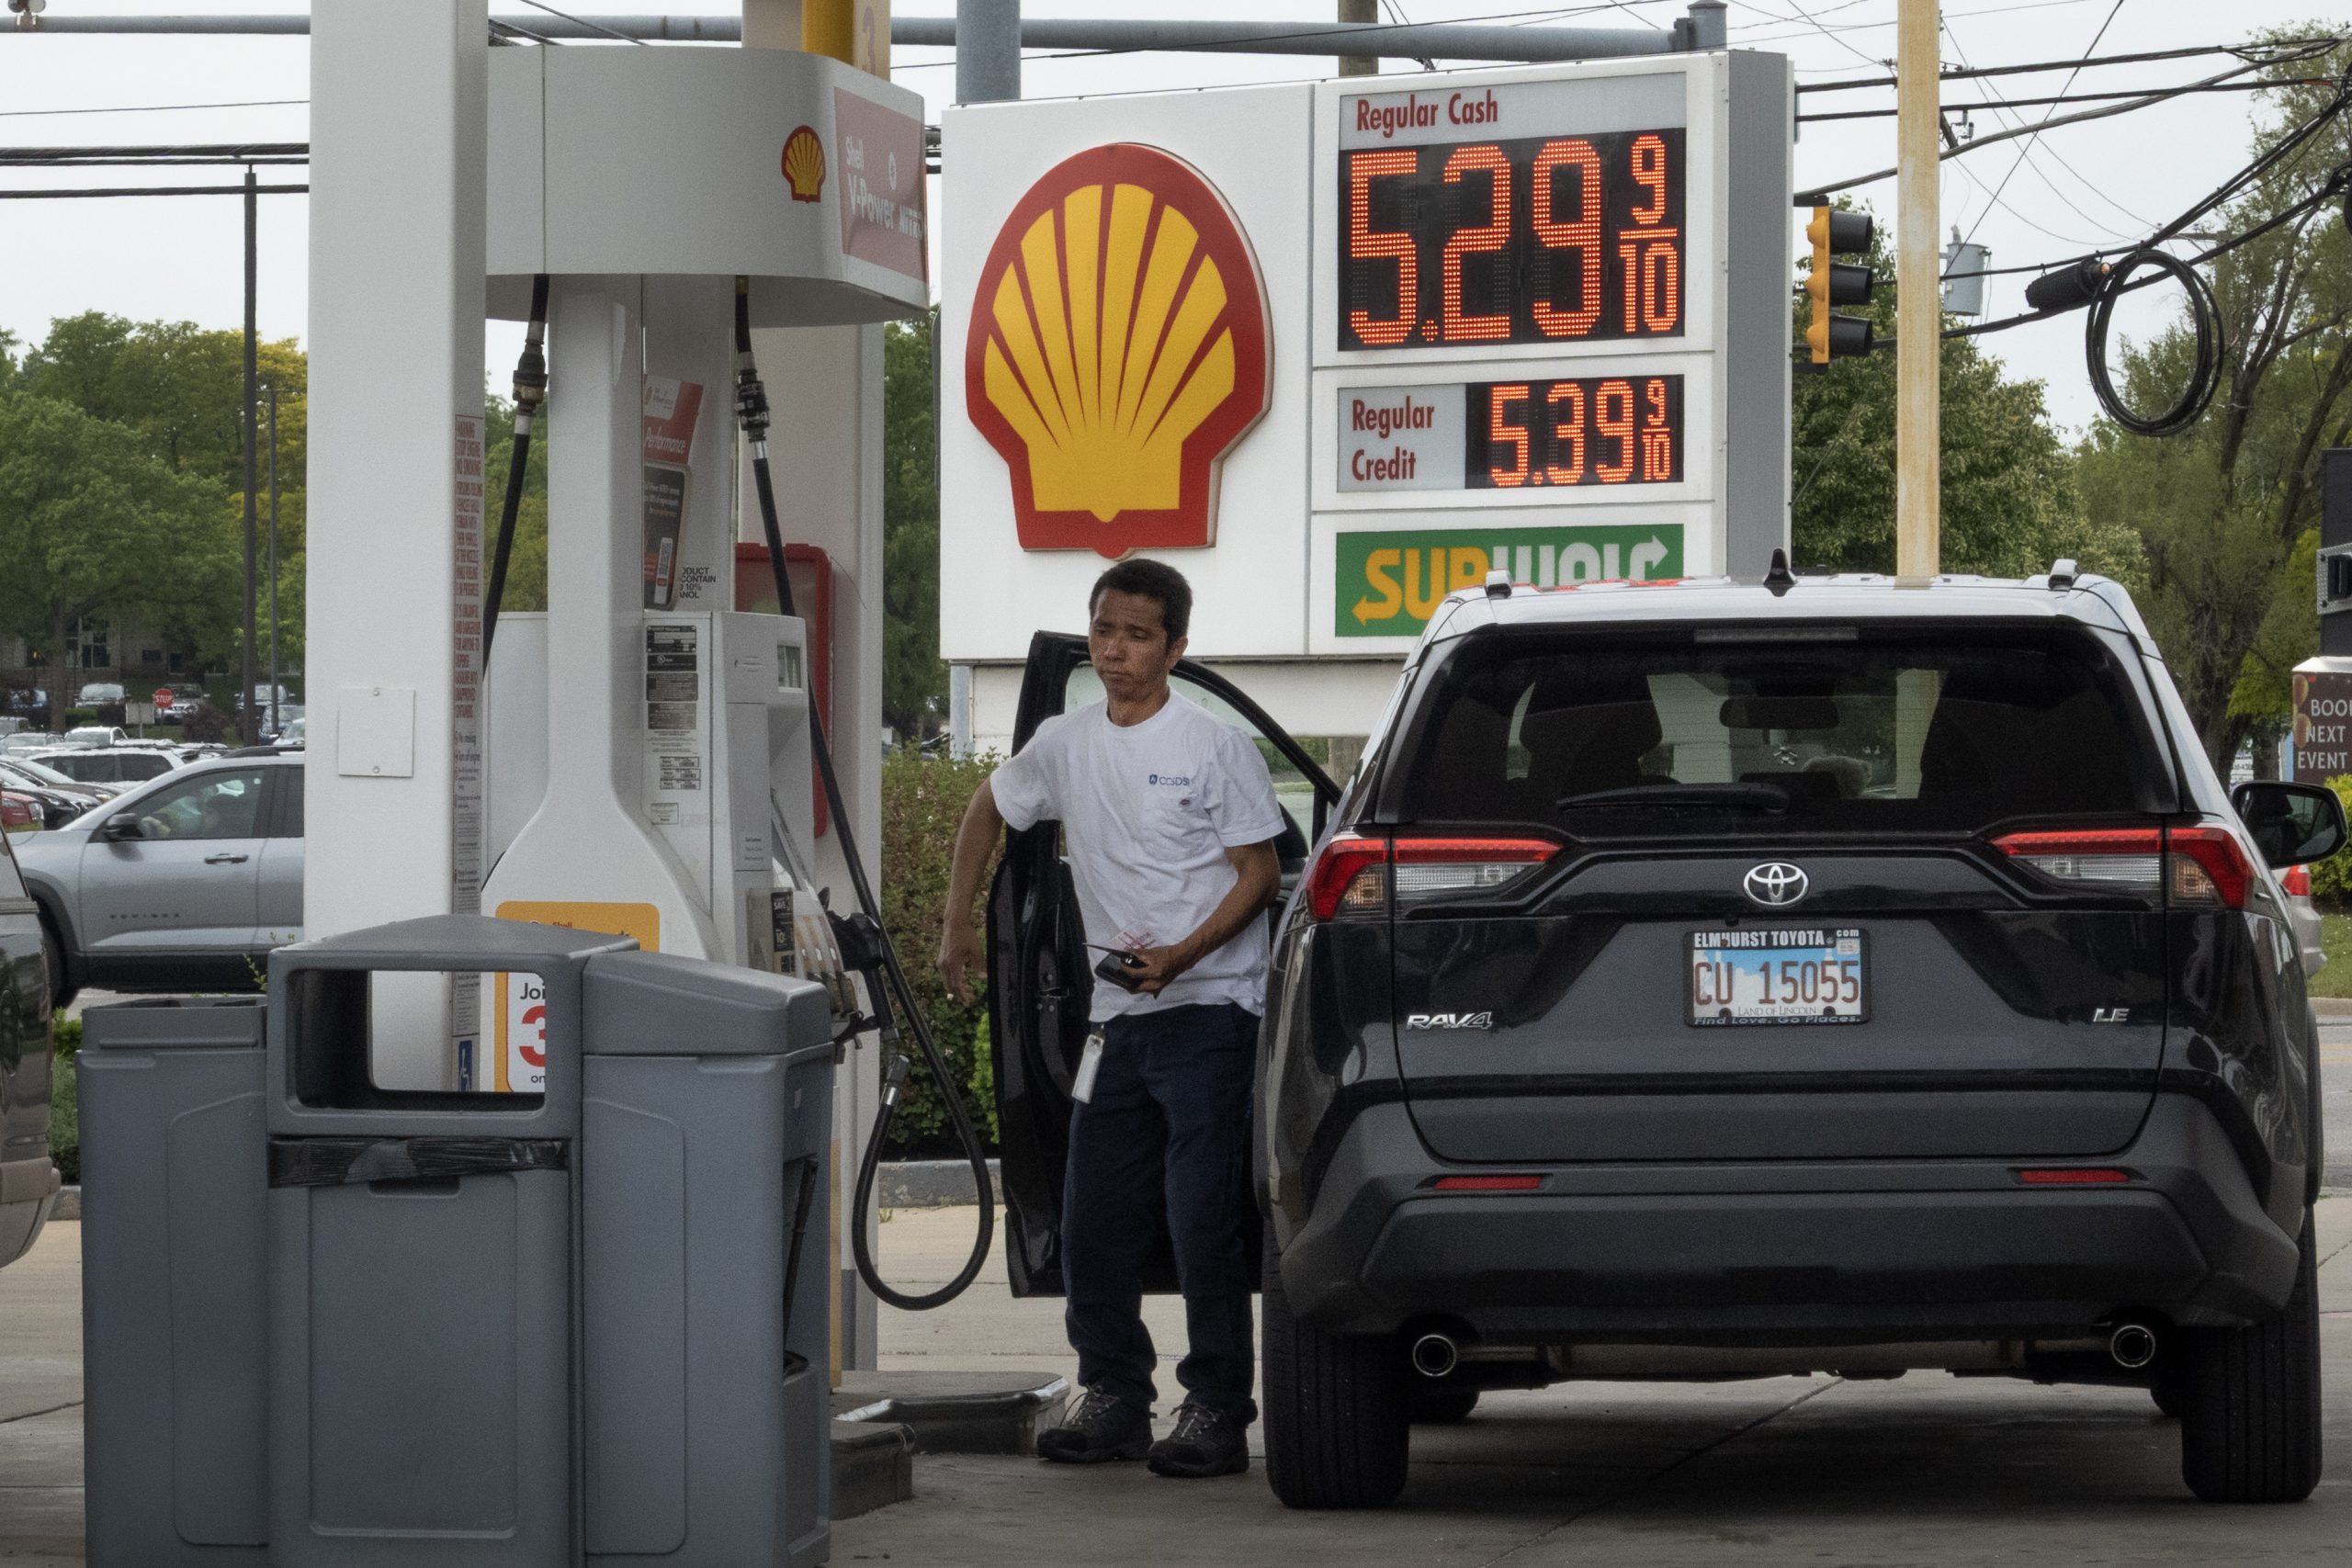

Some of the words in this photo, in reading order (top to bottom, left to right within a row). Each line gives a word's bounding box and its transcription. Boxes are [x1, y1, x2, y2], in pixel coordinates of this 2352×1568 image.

[1356, 94, 1438, 138] Regular
[1448, 89, 1498, 125] Cash
[845, 136, 865, 170] Shell
[848, 173, 895, 230] V-Power
[1351, 140, 1601, 345] 5.29
[1351, 396, 1435, 439] Regular
[1491, 381, 1634, 488] 5.39
[1351, 446, 1416, 481] Credit
[154, 694, 173, 704] STOP
[2311, 699, 2352, 716] BOO
[2306, 726, 2346, 743] NEXT
[2298, 750, 2348, 769] EVENT
[1694, 931, 1768, 948] ELMHURST
[1770, 930, 1825, 946] TOYOTA
[1836, 929, 1860, 938] com
[1694, 961, 1733, 1005] CU
[1758, 960, 1860, 1004] 15055
[1406, 1011, 1493, 1032] RAV4
[1694, 1017, 1726, 1025] Find
[1731, 1017, 1772, 1025] Love.
[1778, 1016, 1800, 1024] Go
[1805, 1015, 1860, 1024] Places.
[2093, 1008, 2130, 1022] LE
